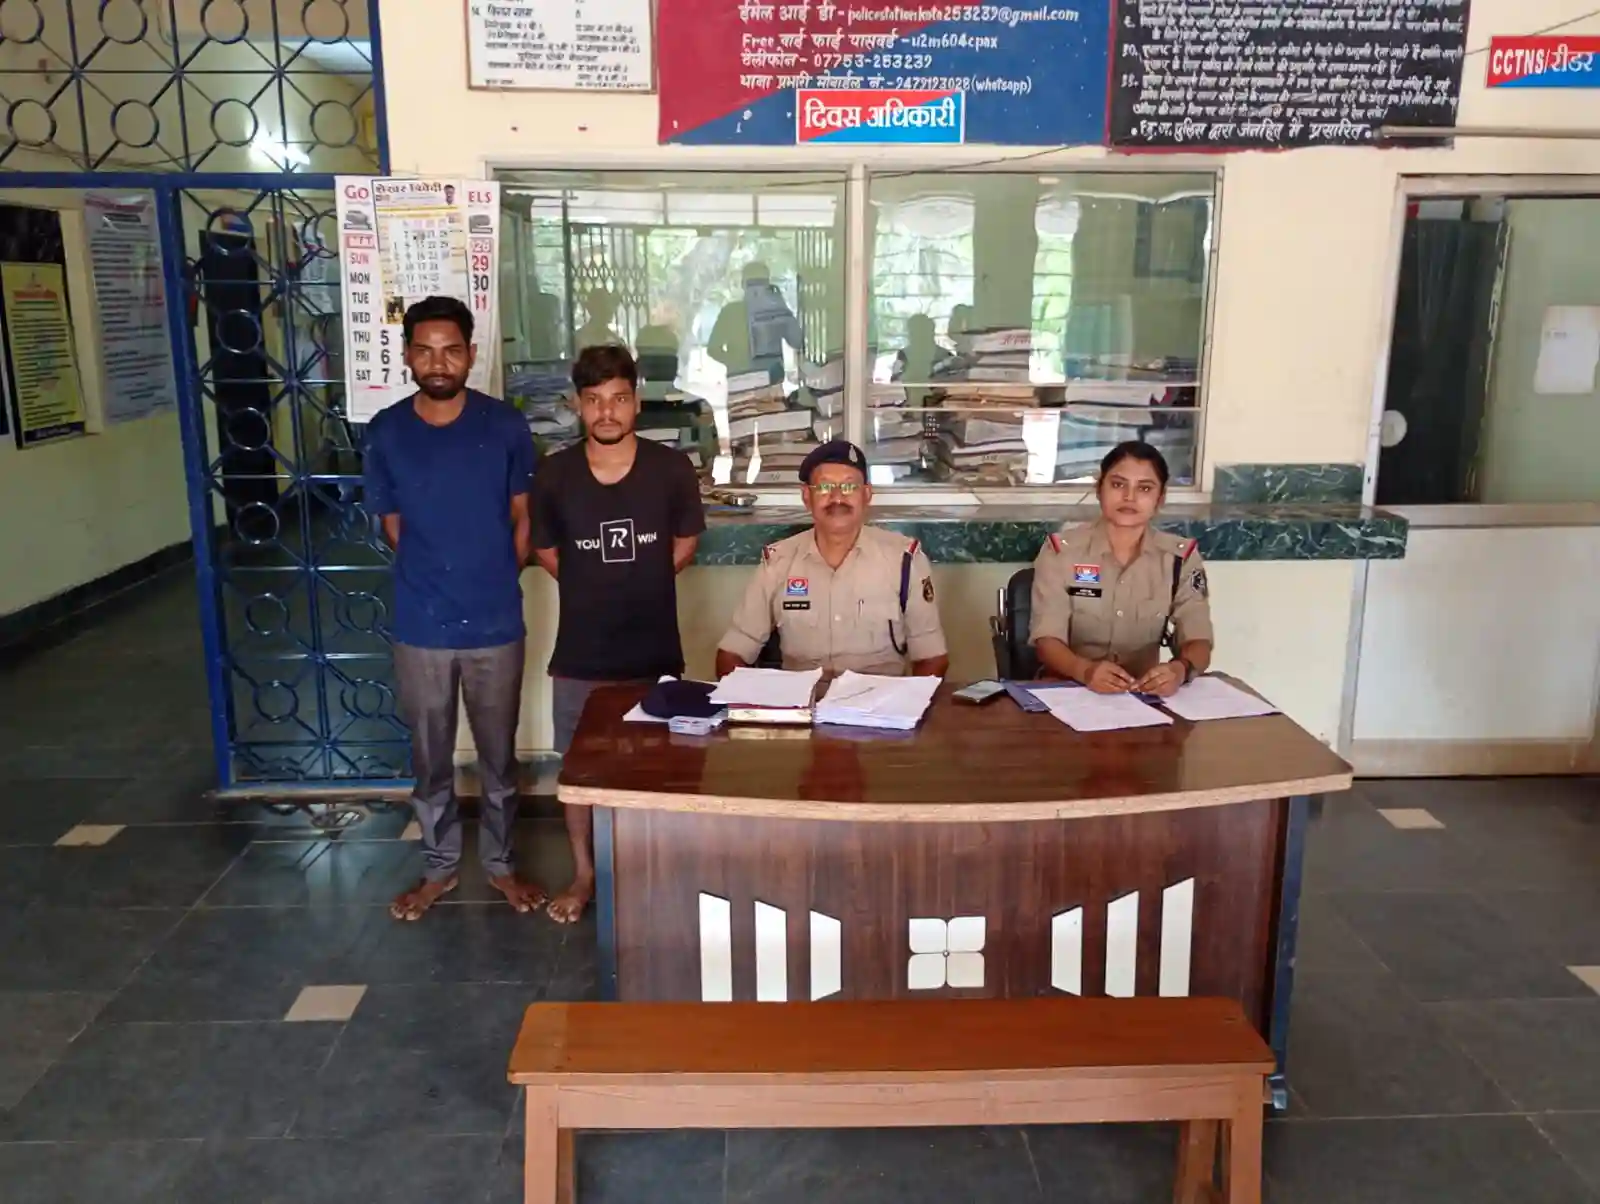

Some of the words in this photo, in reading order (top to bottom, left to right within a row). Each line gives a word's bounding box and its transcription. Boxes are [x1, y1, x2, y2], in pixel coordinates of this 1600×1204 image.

[738, 0, 775, 24] ईमेल
[780, 0, 811, 24] आई
[742, 33, 774, 48] Free
[778, 28, 808, 50] वाई
[811, 28, 845, 51] फाई
[814, 53, 932, 69] 07753-253239
[740, 74, 773, 90] थाना
[776, 70, 813, 89] प्रभारी
[804, 97, 862, 128] दिवस
[867, 96, 956, 128] अधिकारी
[1174, 117, 1207, 142] पुलिस
[1208, 122, 1236, 140] द्वारा
[1309, 118, 1371, 140] प्रसारित
[351, 253, 369, 264] SUN
[472, 255, 489, 271] 29
[350, 272, 370, 284] MON
[473, 274, 489, 291] 30
[352, 292, 369, 304] TUE
[352, 312, 370, 323] WED
[353, 331, 370, 342] THU
[380, 330, 389, 346] 5
[355, 350, 369, 361] FRI
[381, 349, 390, 365] 6
[355, 369, 371, 381] SAT
[381, 368, 390, 384] 7
[575, 539, 600, 550] YOU
[637, 532, 657, 544] WIN
